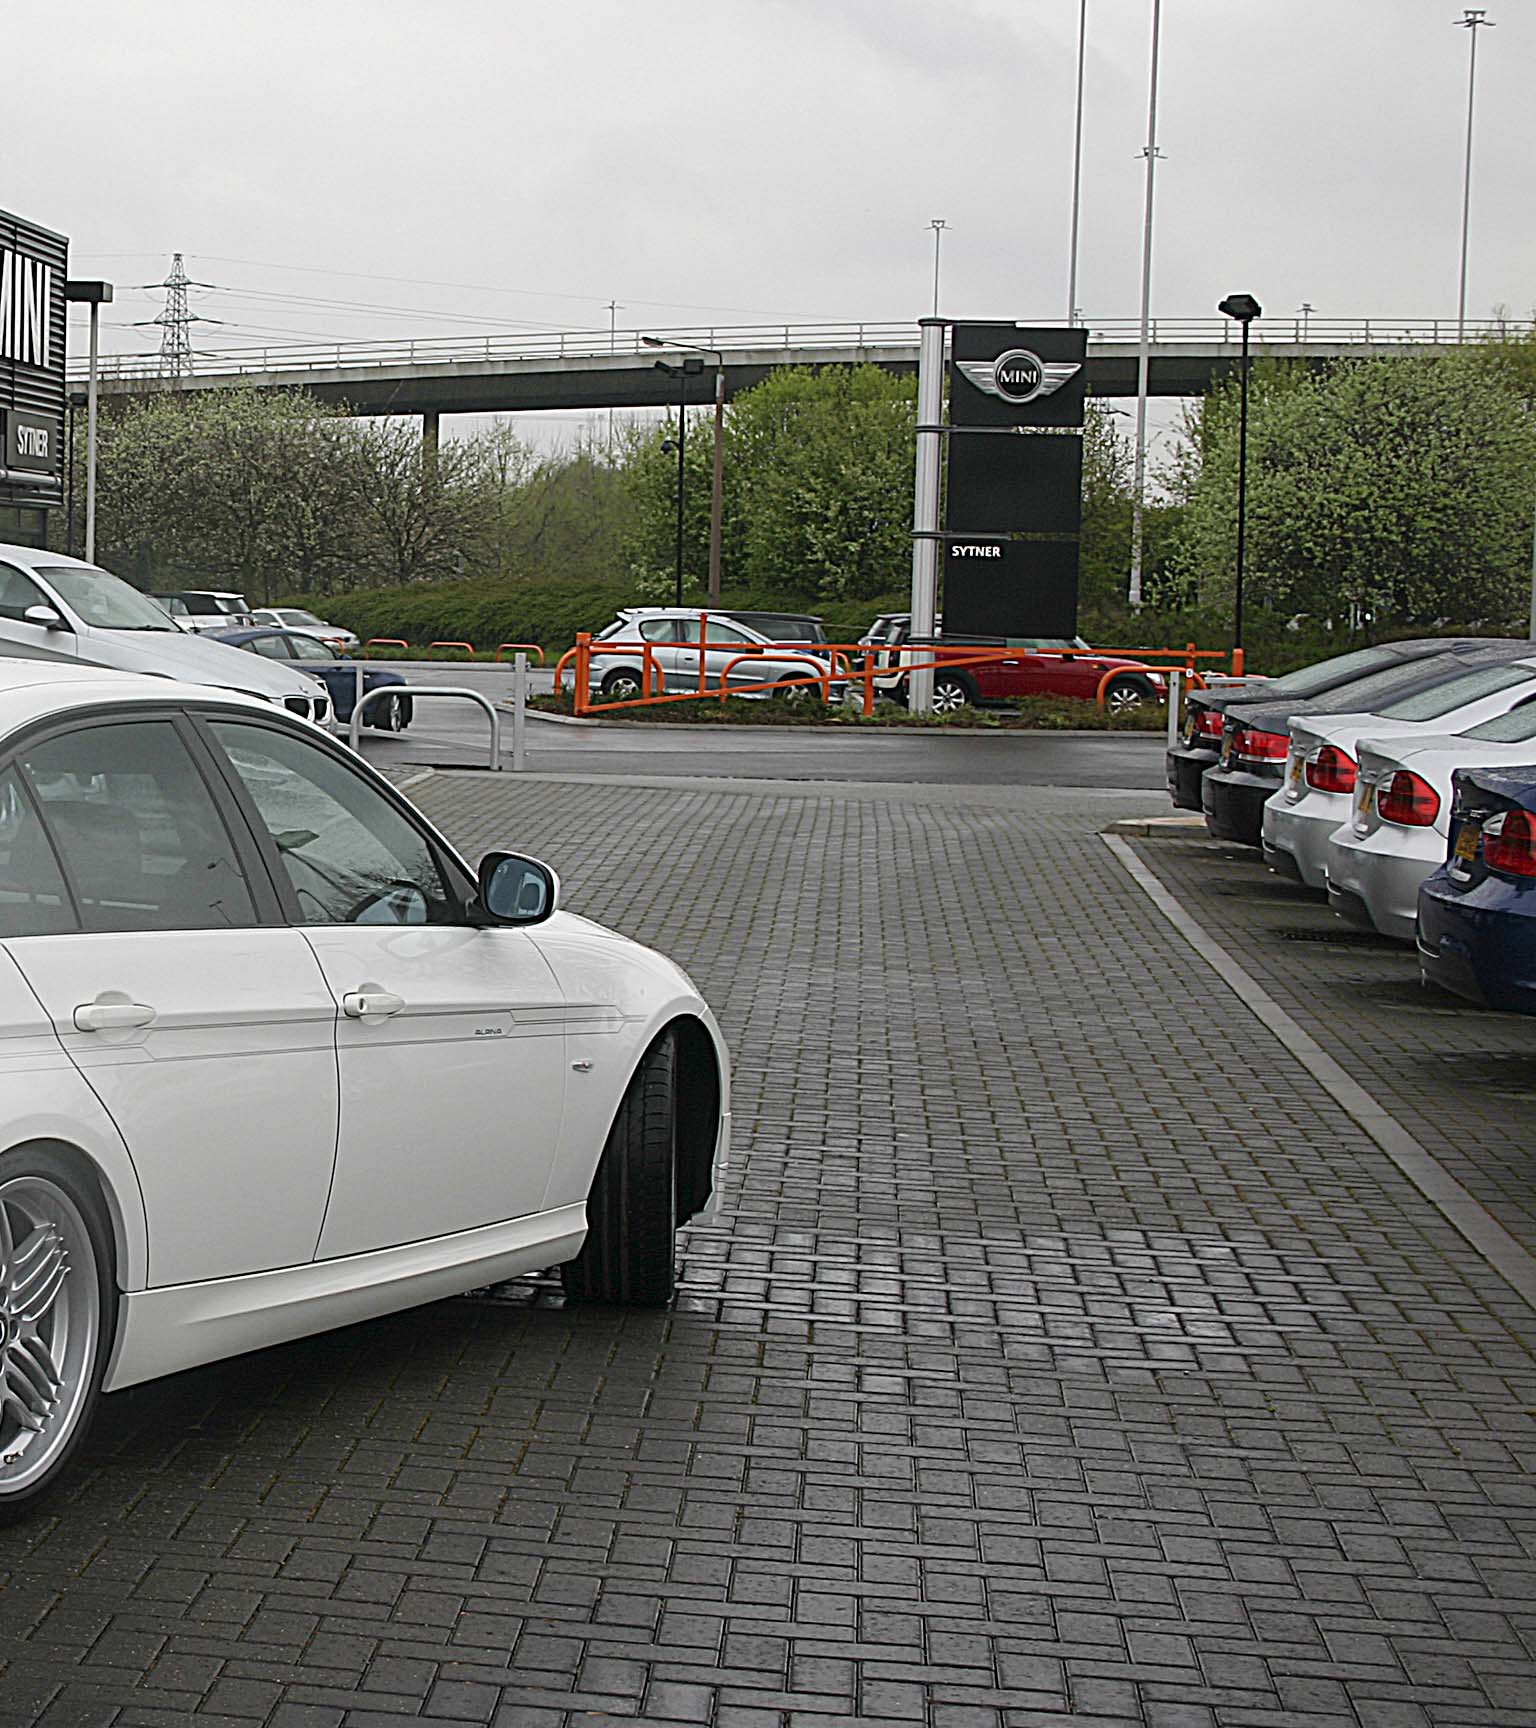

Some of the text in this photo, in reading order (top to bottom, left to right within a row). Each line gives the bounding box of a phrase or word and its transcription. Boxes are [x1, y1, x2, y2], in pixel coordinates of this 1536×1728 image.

[1000, 370, 1037, 383] MINI
[17, 424, 48, 458] SYTNER
[951, 545, 1001, 557] SYTNER
